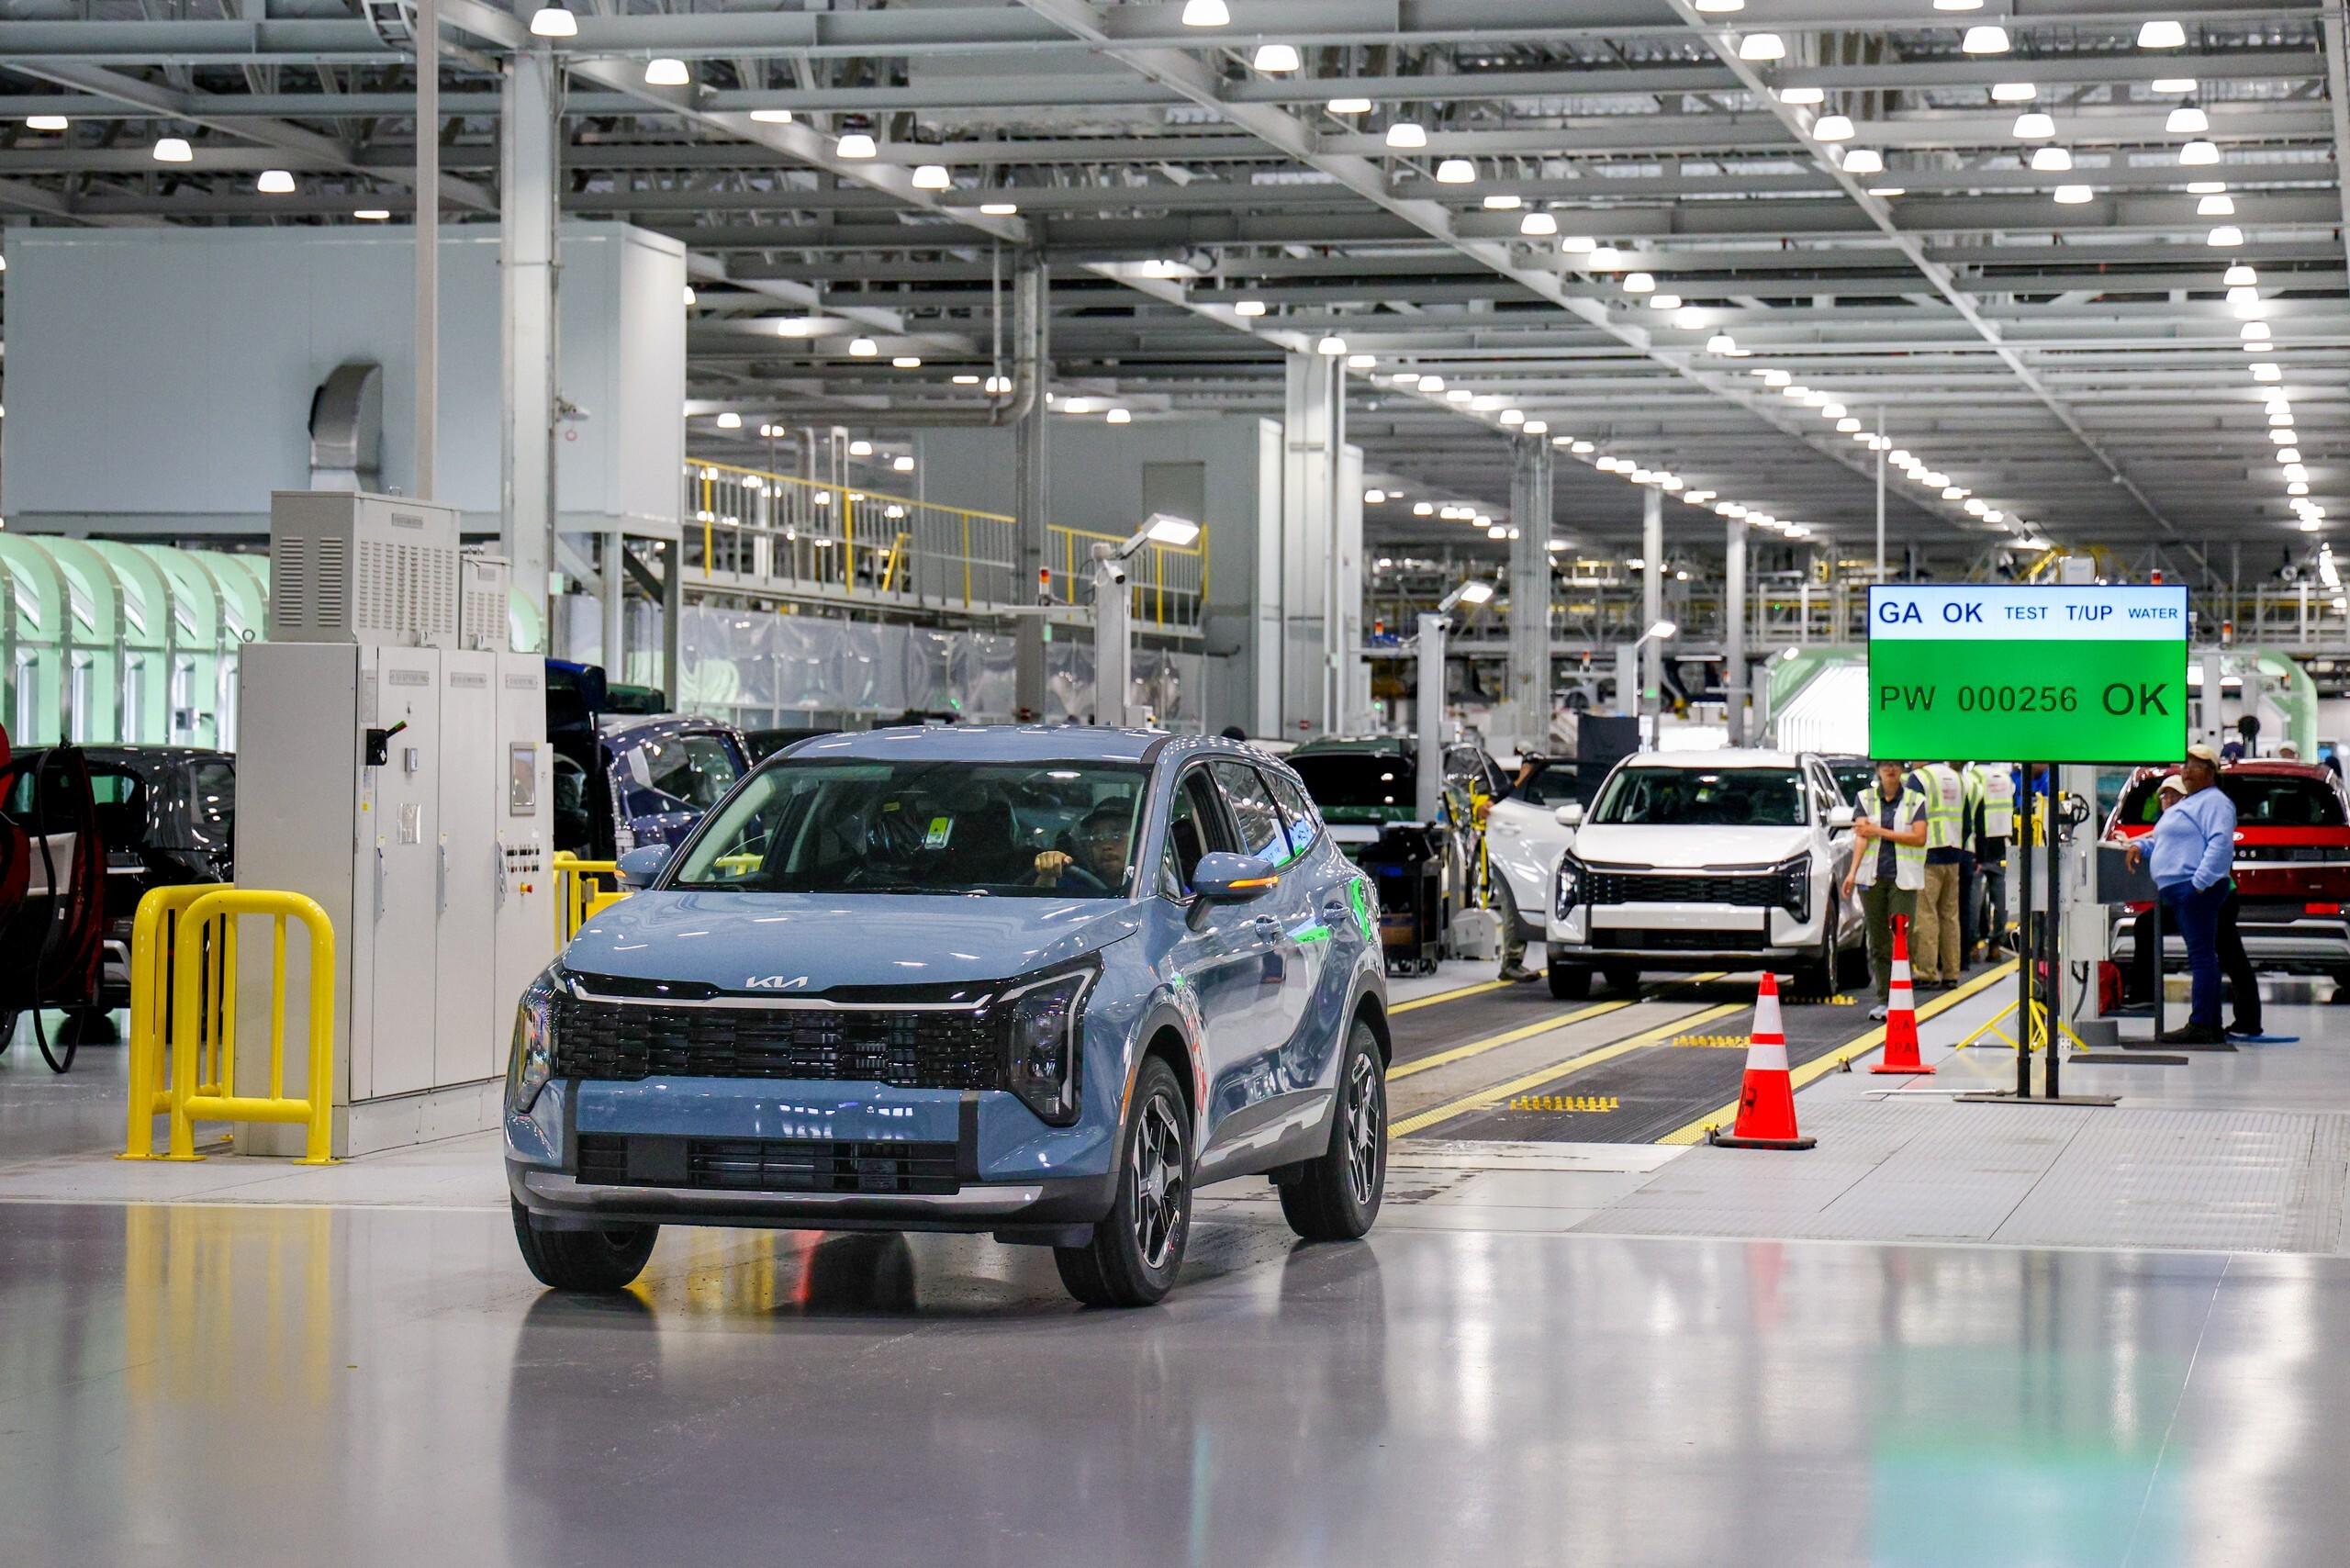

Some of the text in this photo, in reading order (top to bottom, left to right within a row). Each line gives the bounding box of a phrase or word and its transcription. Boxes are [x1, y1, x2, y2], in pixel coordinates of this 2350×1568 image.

[1878, 601, 2178, 624] GA OK TEST T/UP WATER
[1880, 682, 2169, 716] PW 000256 OK
[745, 975, 809, 989] KIA
